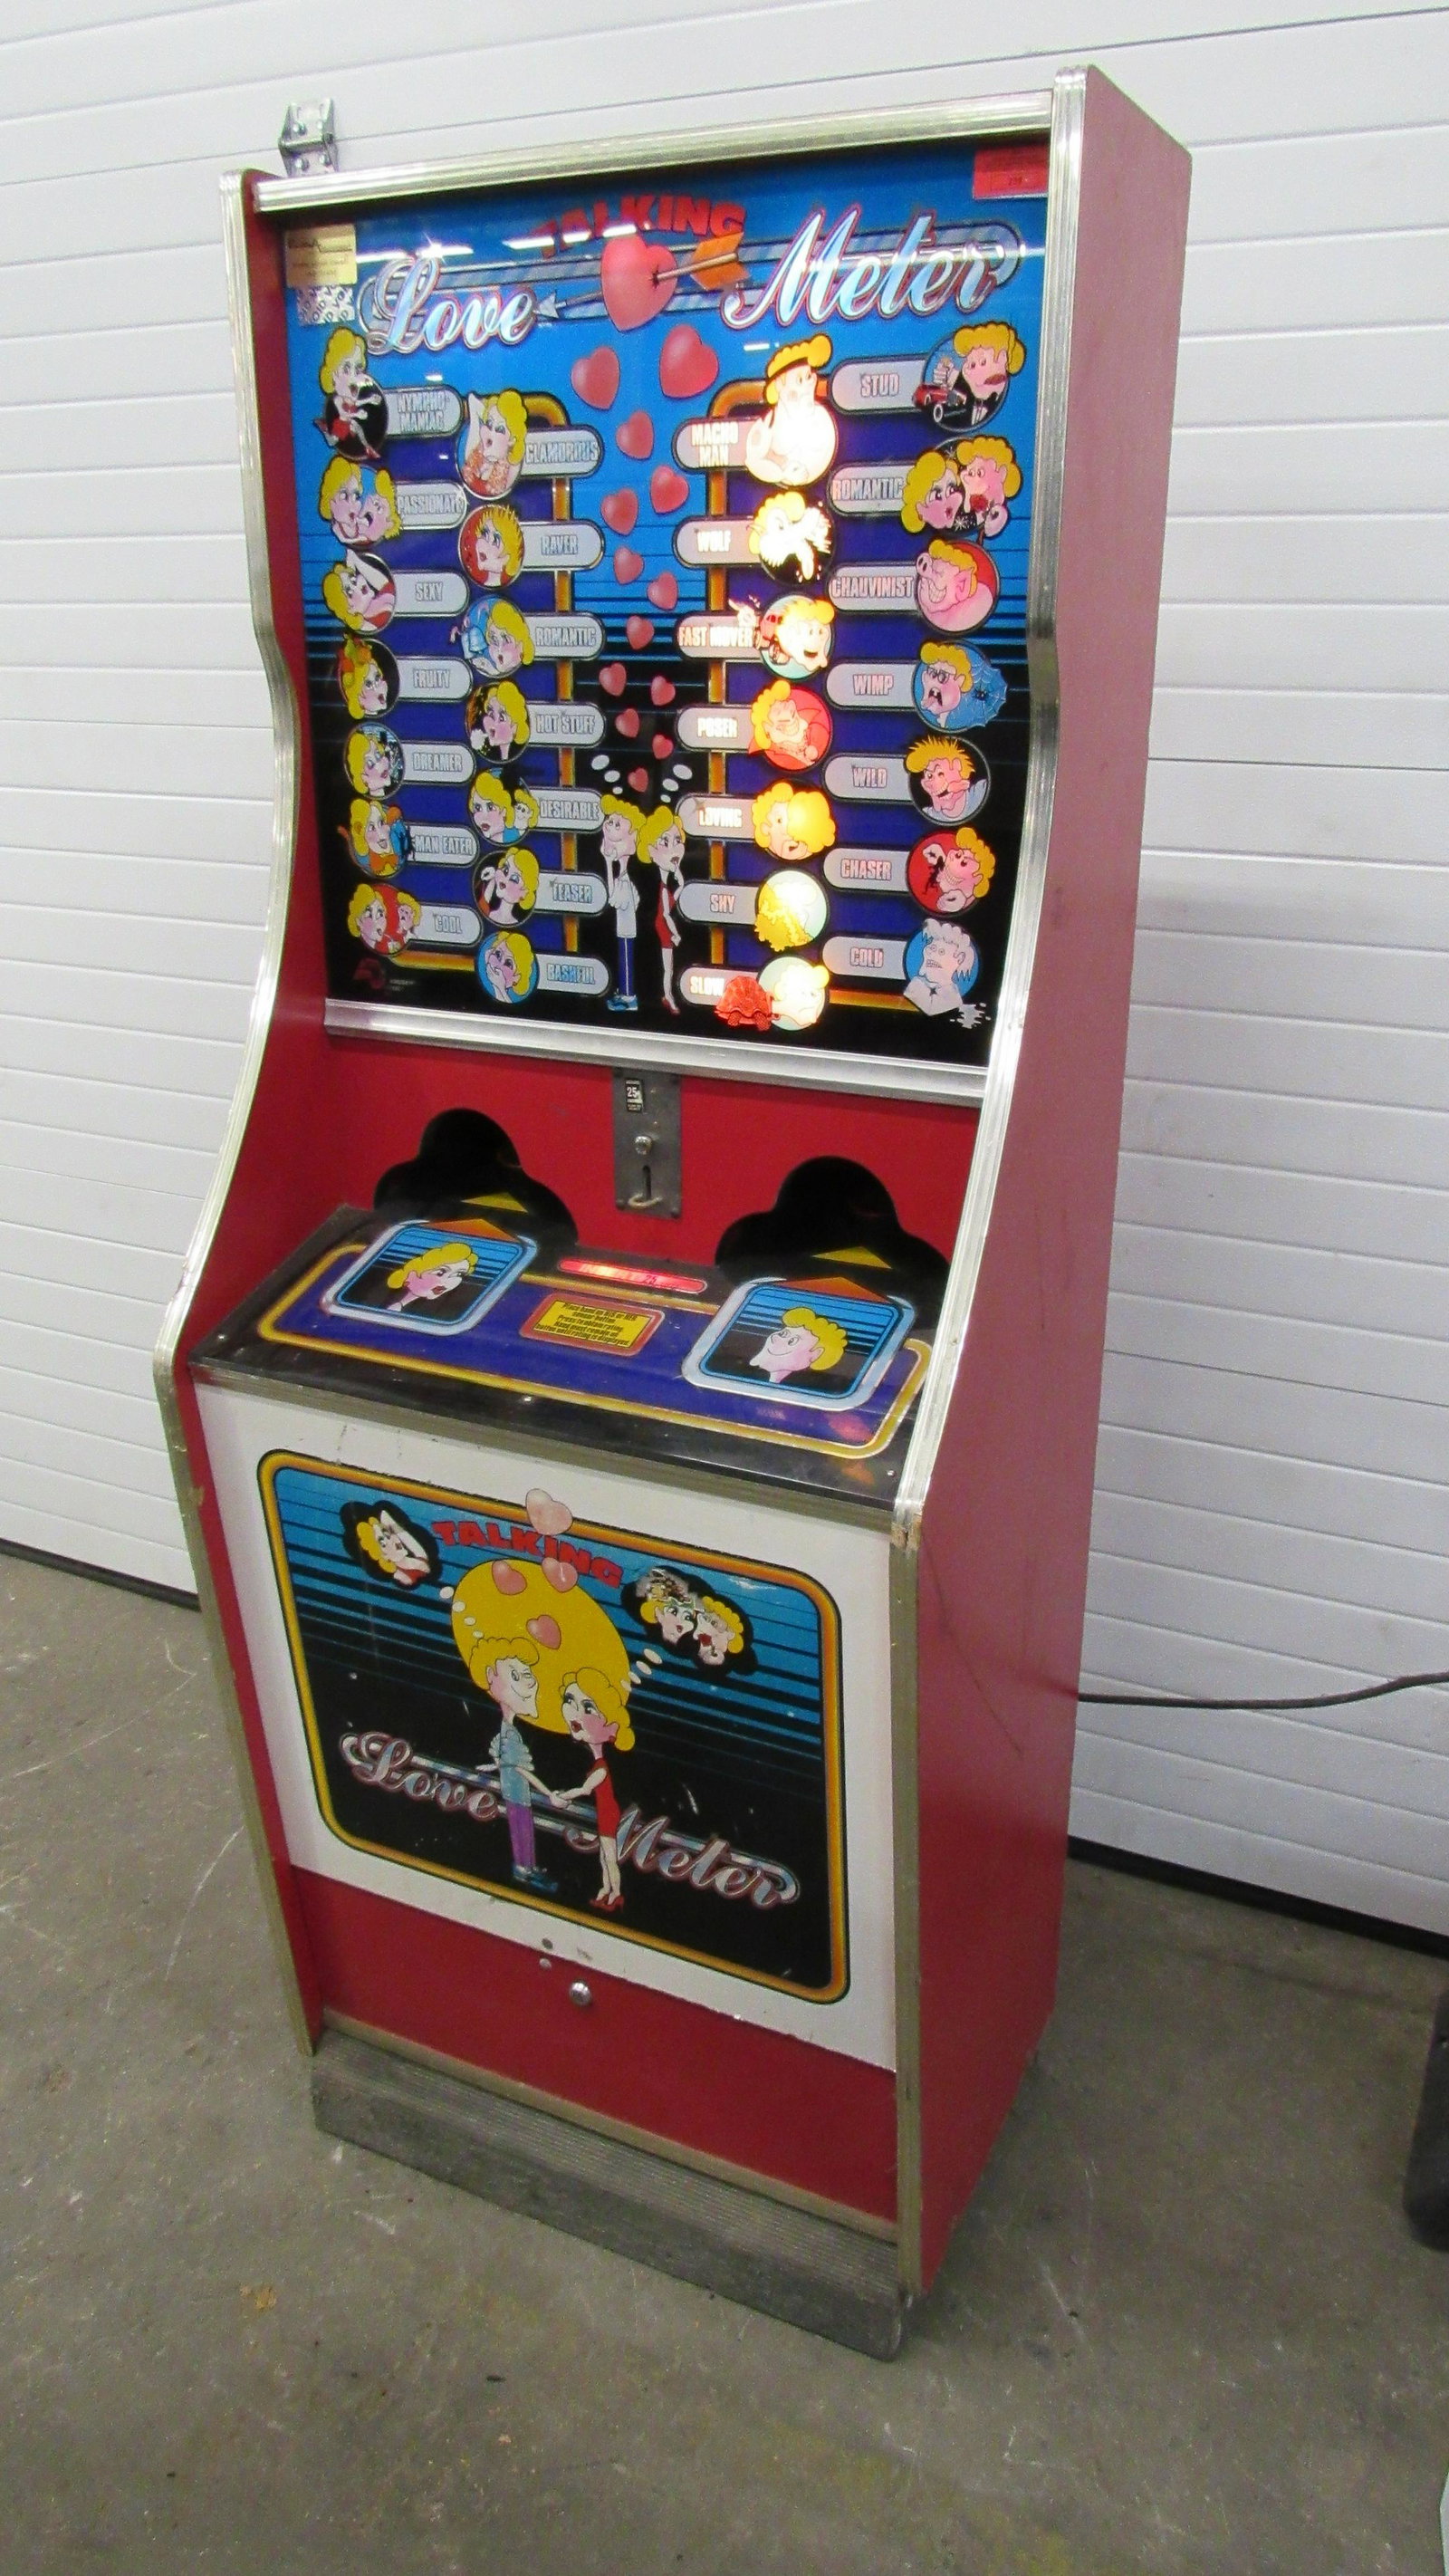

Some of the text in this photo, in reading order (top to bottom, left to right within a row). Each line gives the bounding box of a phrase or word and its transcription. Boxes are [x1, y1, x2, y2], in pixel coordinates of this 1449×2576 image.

[529, 195, 746, 258] TALKING
[364, 203, 998, 355] Love Meter
[861, 374, 900, 397] STUD
[398, 411, 445, 433] MANIAC
[691, 422, 738, 446] MACHO
[525, 441, 599, 464] GLAMOROUS
[699, 445, 729, 467] MAN
[832, 477, 905, 500] ROMANTIC
[397, 492, 465, 514] PASSIONATE
[541, 534, 579, 556] RAVER
[696, 530, 732, 553] WOLF
[415, 582, 443, 601] SEXY
[830, 576, 915, 598] CHAUVINIST
[535, 627, 597, 648] ROMANTIC
[678, 626, 753, 648] FAST MOVER
[413, 668, 450, 688] FRUITY
[853, 674, 895, 696] WIMP
[535, 714, 596, 735] HOT STUFF
[697, 717, 738, 738] POSER
[412, 753, 463, 773] DREAMER
[853, 768, 888, 788] WILD
[539, 799, 600, 822] DESIRABLE
[698, 807, 743, 828] LOVING
[414, 834, 475, 856] MAN EATER
[840, 859, 892, 881] CHASER
[552, 882, 593, 904] TEASER
[710, 894, 735, 914] SHY
[434, 914, 462, 934] COOL
[849, 947, 884, 968] COLD
[547, 962, 596, 985] BASHFUL
[690, 976, 724, 996] SLOW
[431, 1521, 624, 1589] TALKING
[350, 1731, 781, 1909] Love Meter
